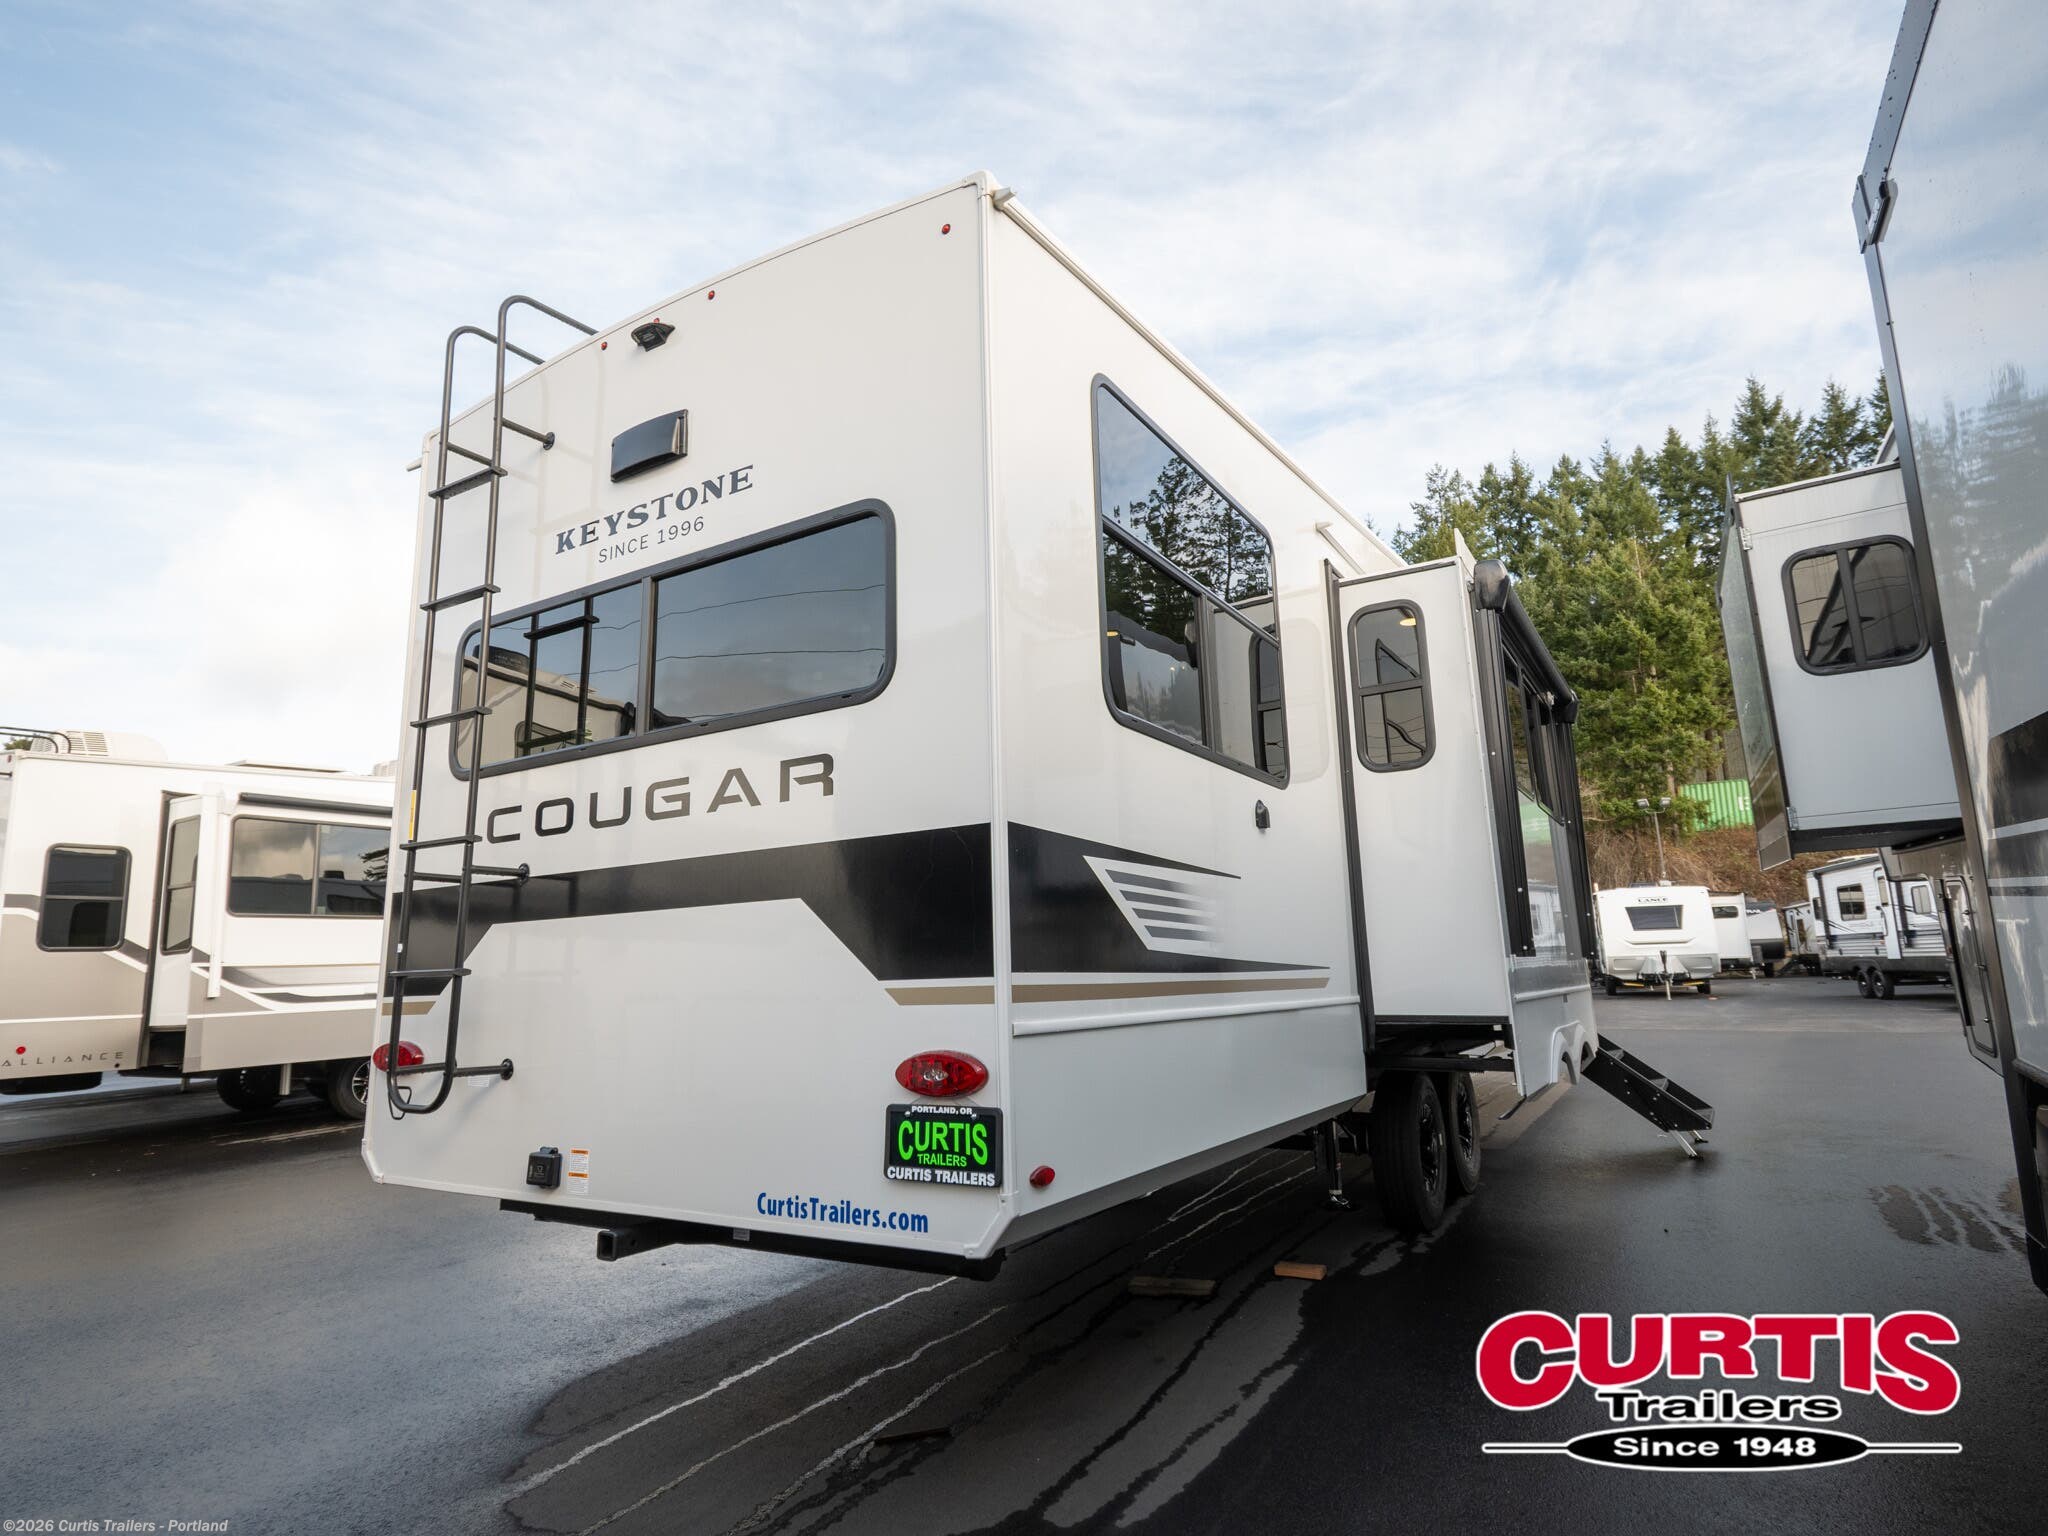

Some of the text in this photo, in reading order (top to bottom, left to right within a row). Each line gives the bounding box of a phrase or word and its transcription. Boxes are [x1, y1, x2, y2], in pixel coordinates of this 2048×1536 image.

[555, 464, 753, 555] KEYSTONE
[598, 516, 704, 563] SINCE 1996
[487, 753, 834, 843] COUGAR
[2, 1052, 123, 1066] ALLIANCE
[911, 1106, 958, 1114] PORTLAND,
[898, 1120, 988, 1165] CURTIS
[917, 1153, 967, 1167] TRAILERS
[887, 1166, 995, 1187] CURTIS TRAILERS
[757, 1192, 928, 1233] CurtisTrailers.com
